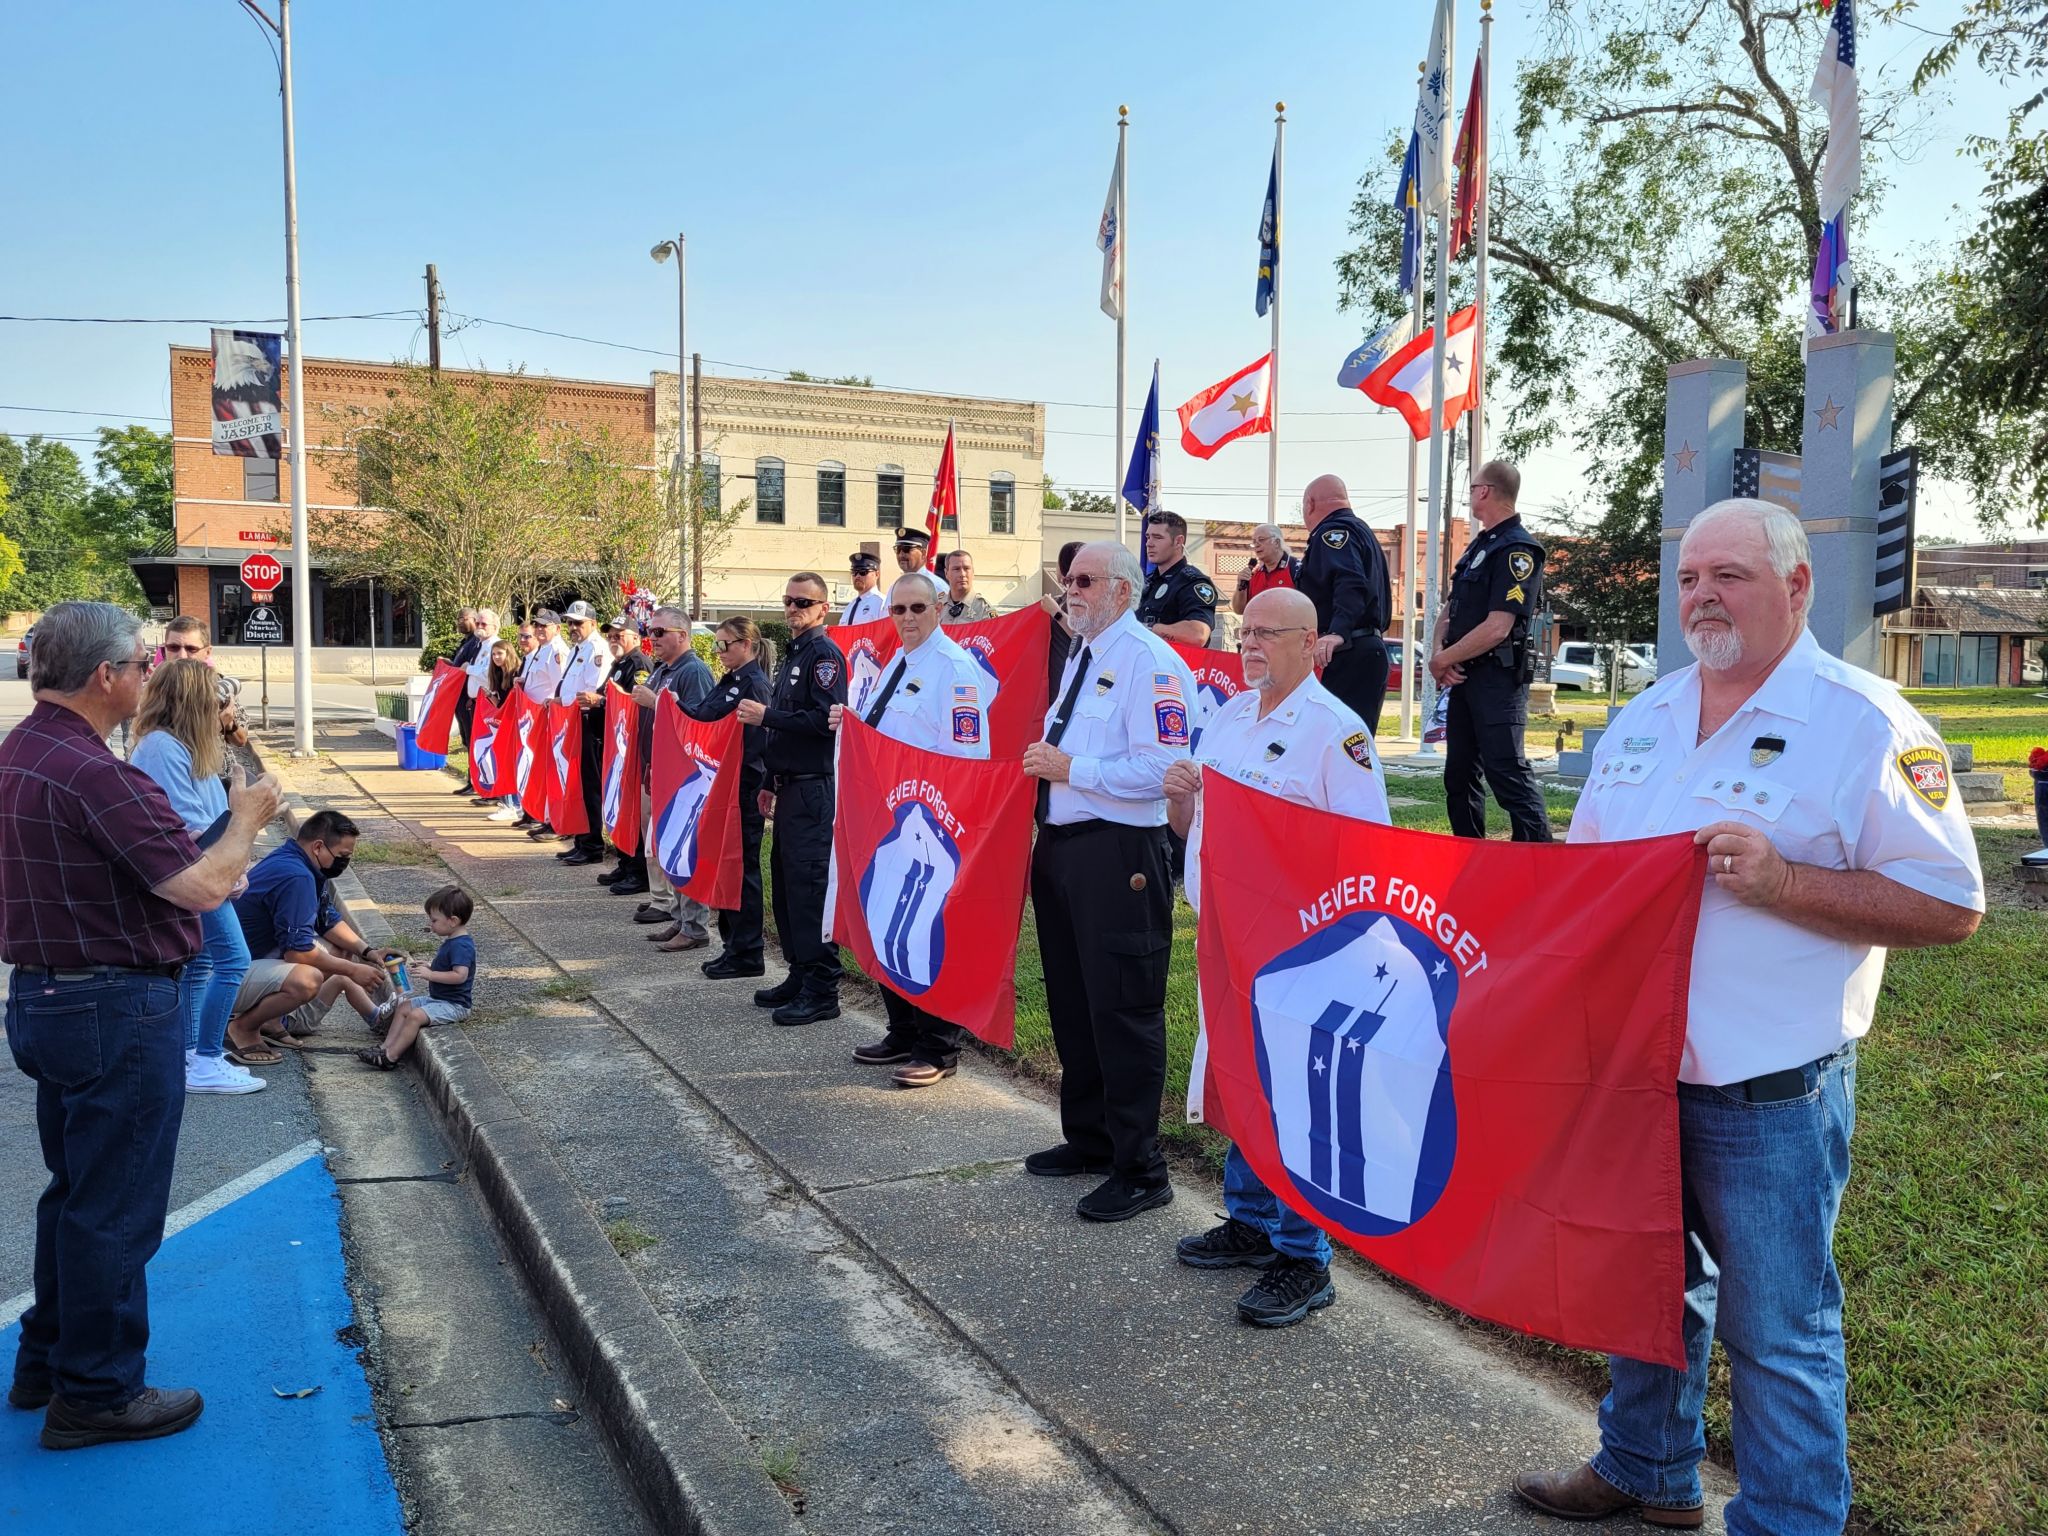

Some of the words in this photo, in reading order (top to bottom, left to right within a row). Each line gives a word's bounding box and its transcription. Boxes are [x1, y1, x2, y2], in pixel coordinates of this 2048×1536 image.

[221, 417, 259, 429] WELCOME
[261, 414, 272, 422] TO
[221, 422, 273, 440] JASPER
[244, 565, 280, 580] STOP
[246, 631, 281, 639] District
[1208, 667, 1241, 697] FORG
[1902, 749, 1944, 766] EVADALE
[919, 779, 966, 840] FORGET
[1298, 874, 1377, 933] NEVER
[1385, 876, 1488, 978] FORGET
